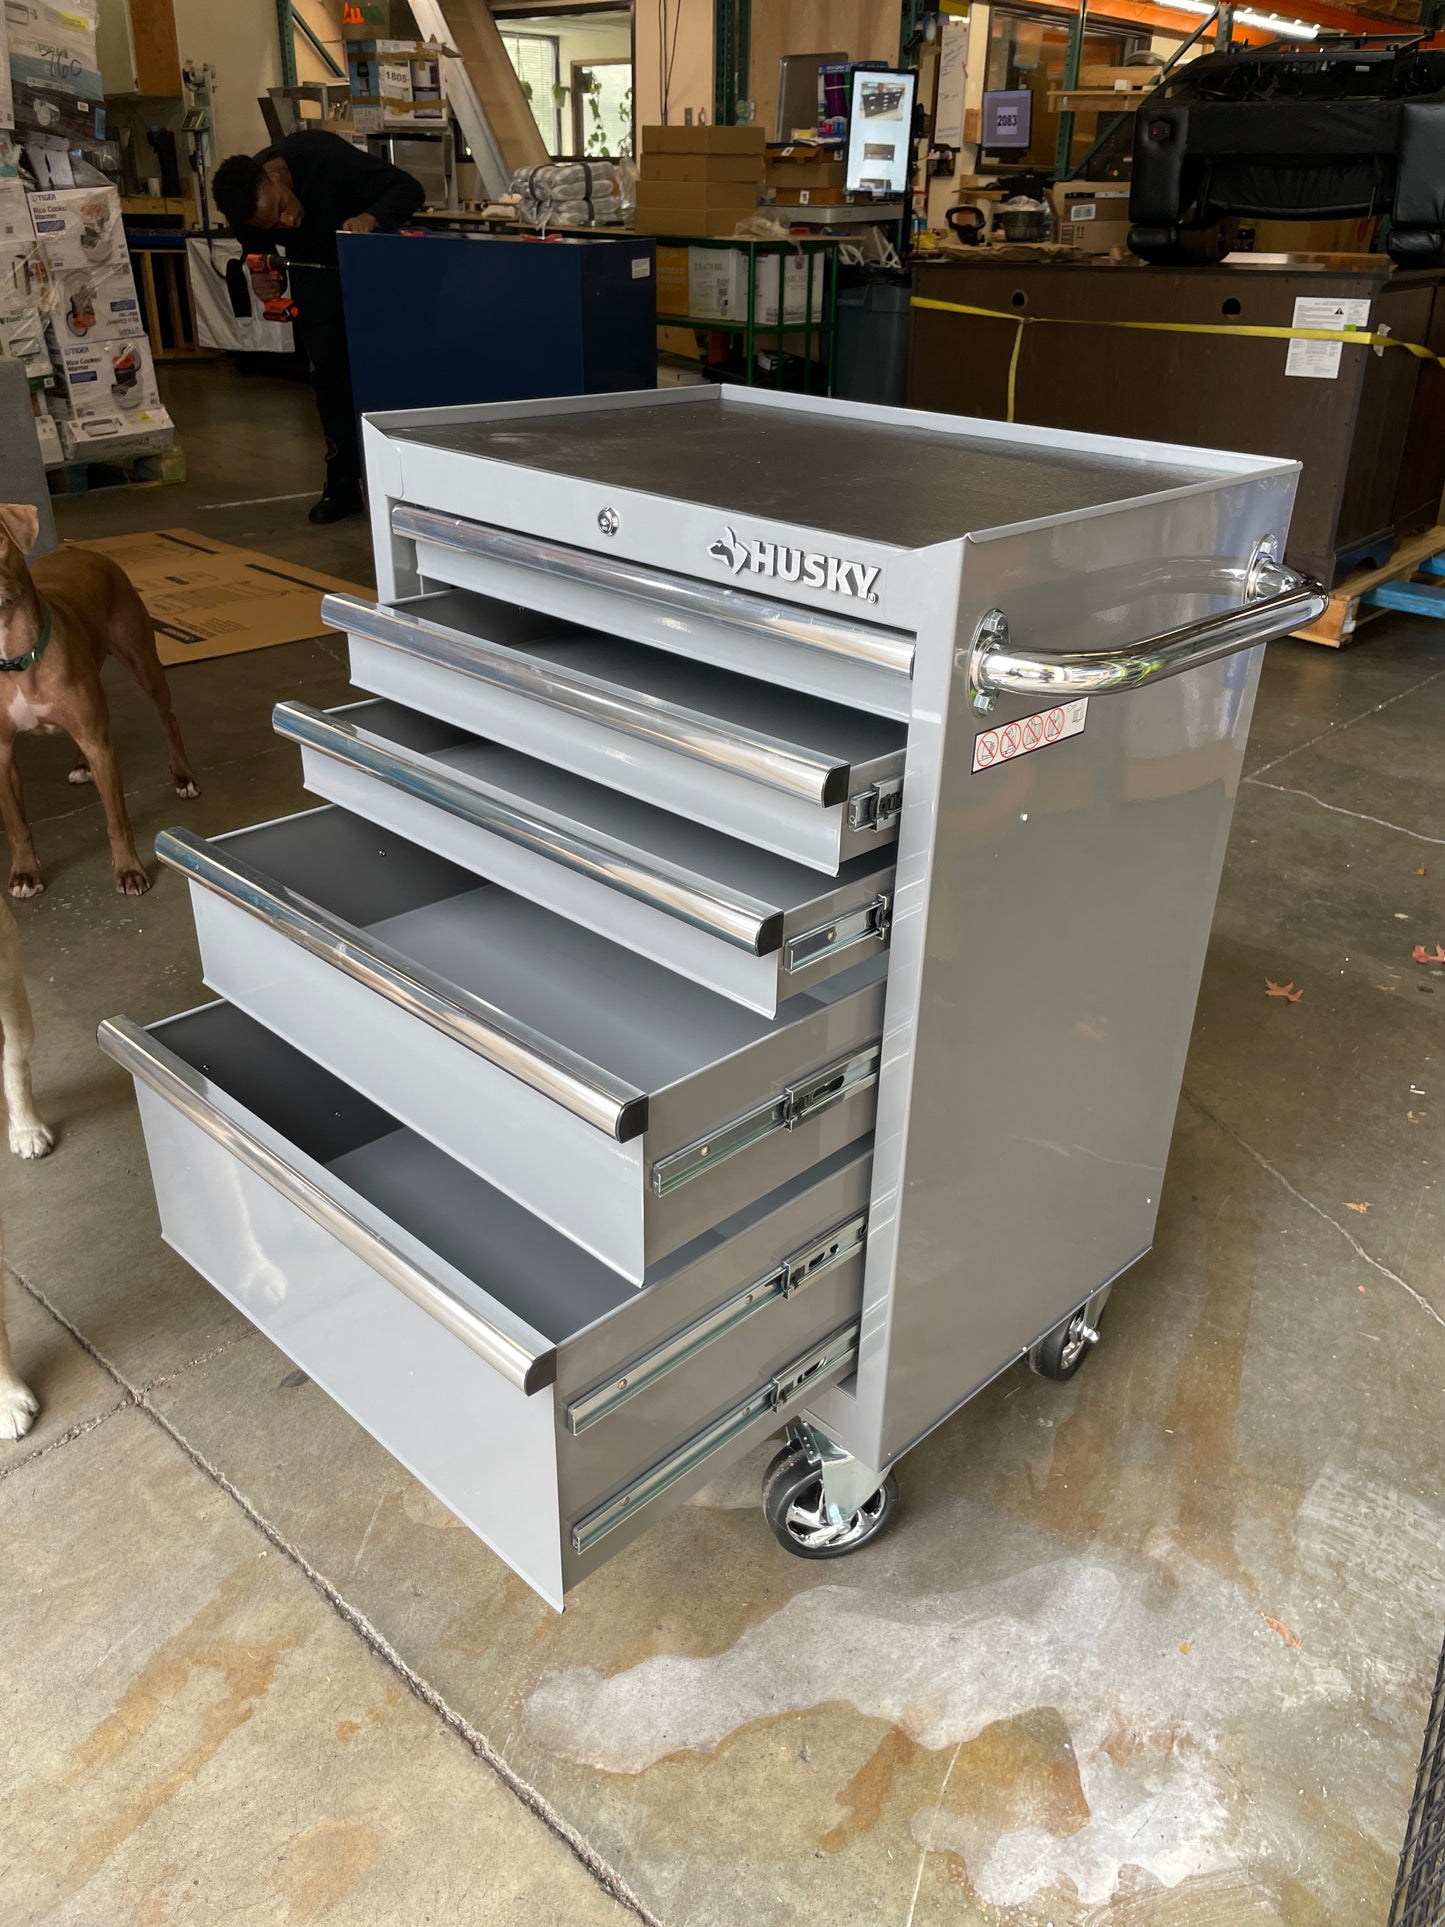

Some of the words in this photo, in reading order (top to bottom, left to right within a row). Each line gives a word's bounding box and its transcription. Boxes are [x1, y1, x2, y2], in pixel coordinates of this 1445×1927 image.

[386, 71, 407, 83] 1805
[997, 115, 1017, 127] 2083
[38, 194, 56, 202] TIGER
[71, 346, 89, 355] TIGER
